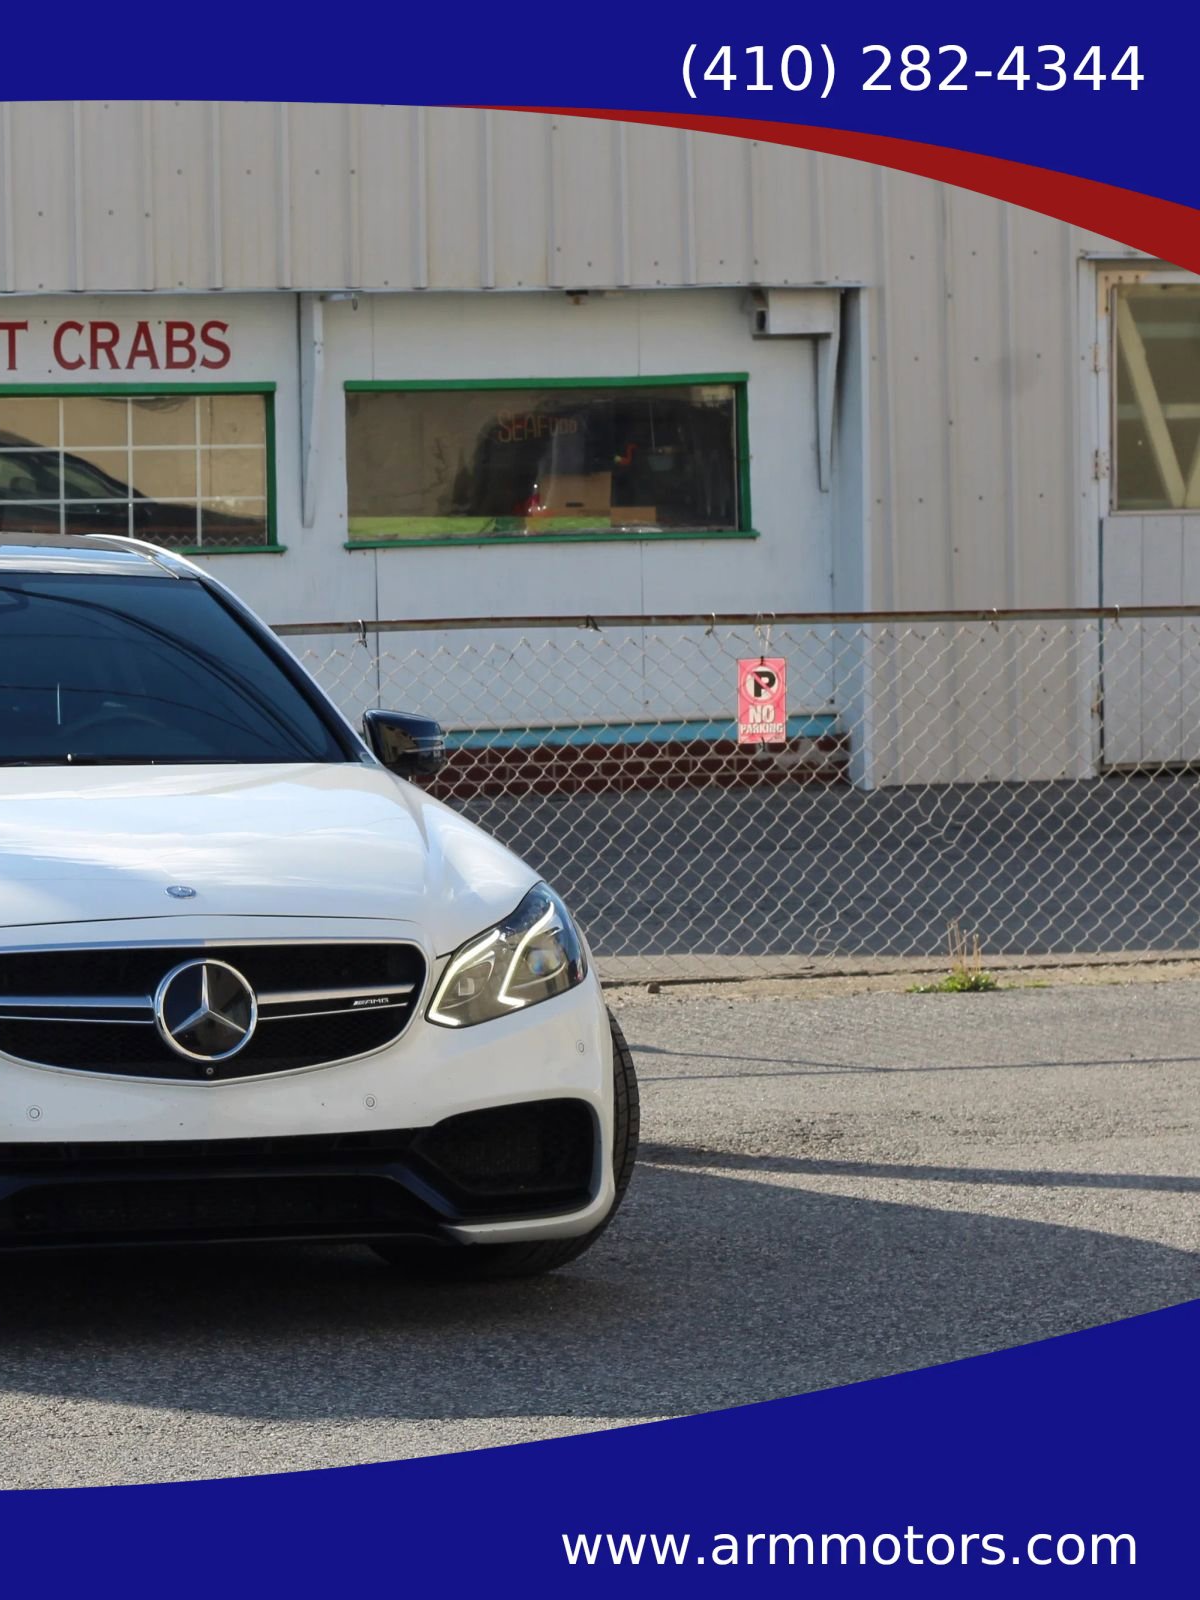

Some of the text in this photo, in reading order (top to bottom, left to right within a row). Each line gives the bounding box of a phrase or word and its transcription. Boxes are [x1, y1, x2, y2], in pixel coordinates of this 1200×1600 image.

[53, 320, 232, 371] CRABS
[749, 704, 775, 723] NO
[740, 723, 784, 734] PARKING
